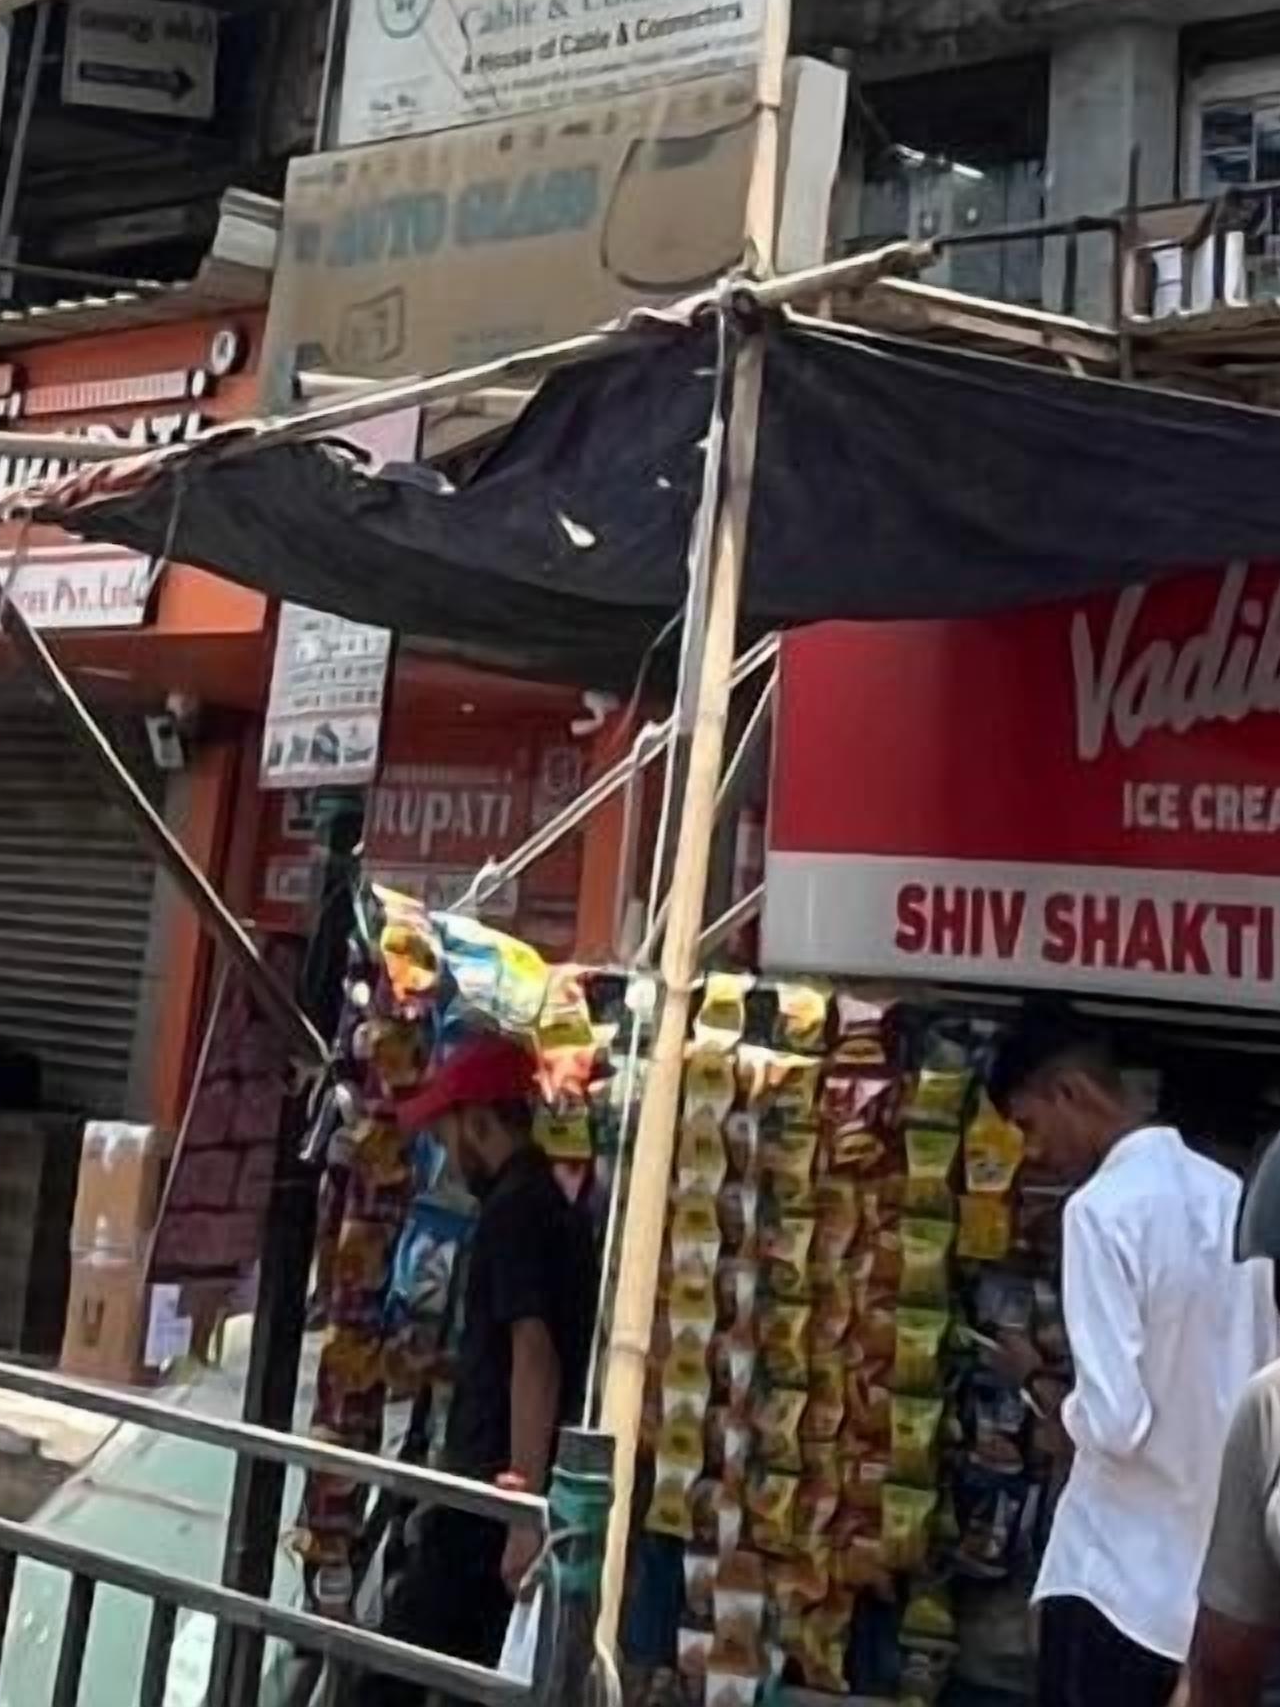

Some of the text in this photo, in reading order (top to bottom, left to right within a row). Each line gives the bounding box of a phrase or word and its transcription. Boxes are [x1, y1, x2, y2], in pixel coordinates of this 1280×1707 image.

[373, 789, 512, 855] RUPATI
[1123, 780, 1181, 830] ICE
[894, 882, 1027, 959] SHIV
[1040, 894, 1276, 982] SHAKTI
